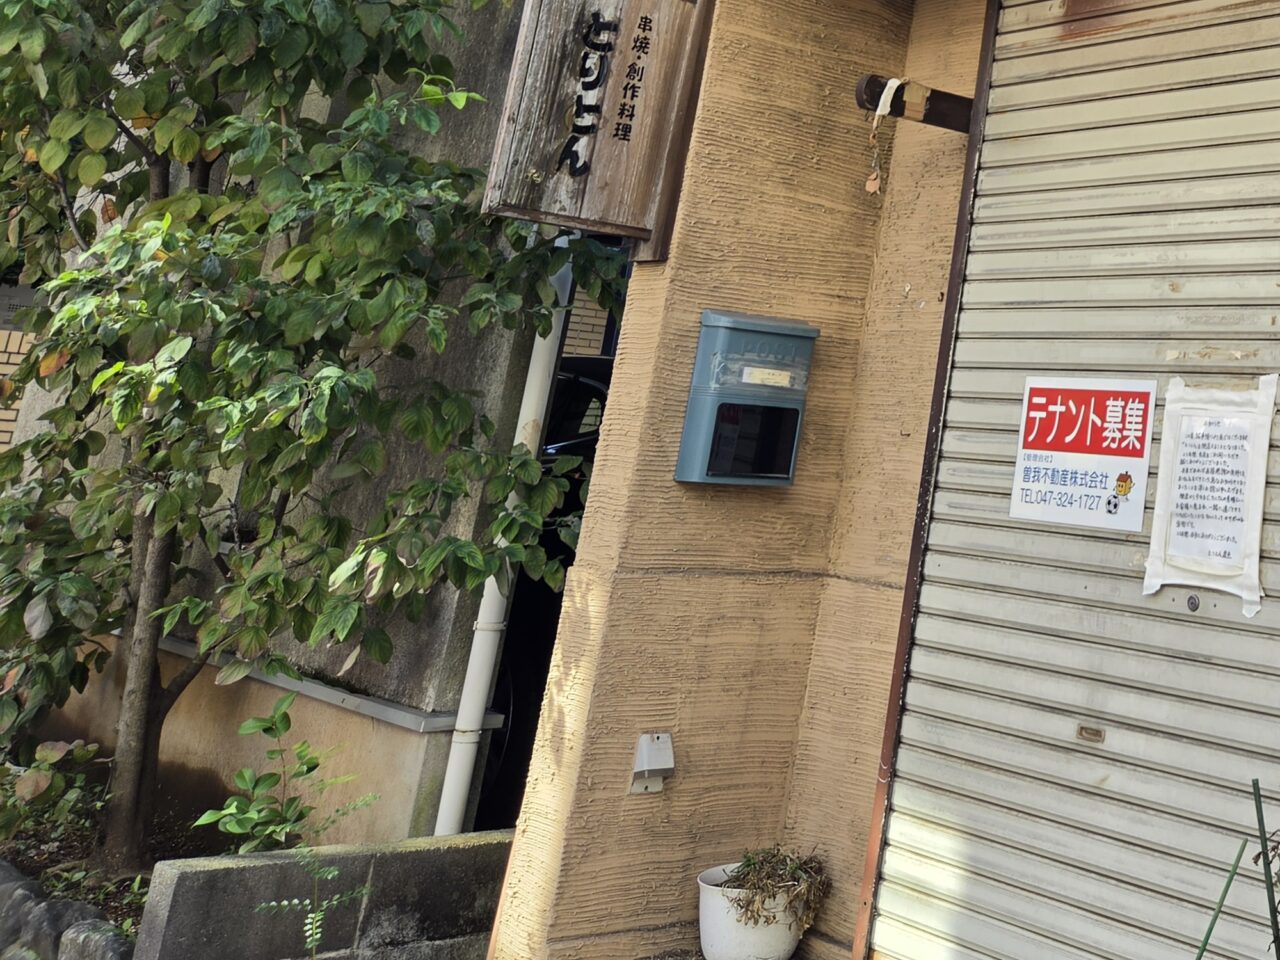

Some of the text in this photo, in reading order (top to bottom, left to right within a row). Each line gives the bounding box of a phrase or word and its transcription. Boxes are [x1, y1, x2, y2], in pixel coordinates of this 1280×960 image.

[1027, 394, 1146, 451] テナント募集
